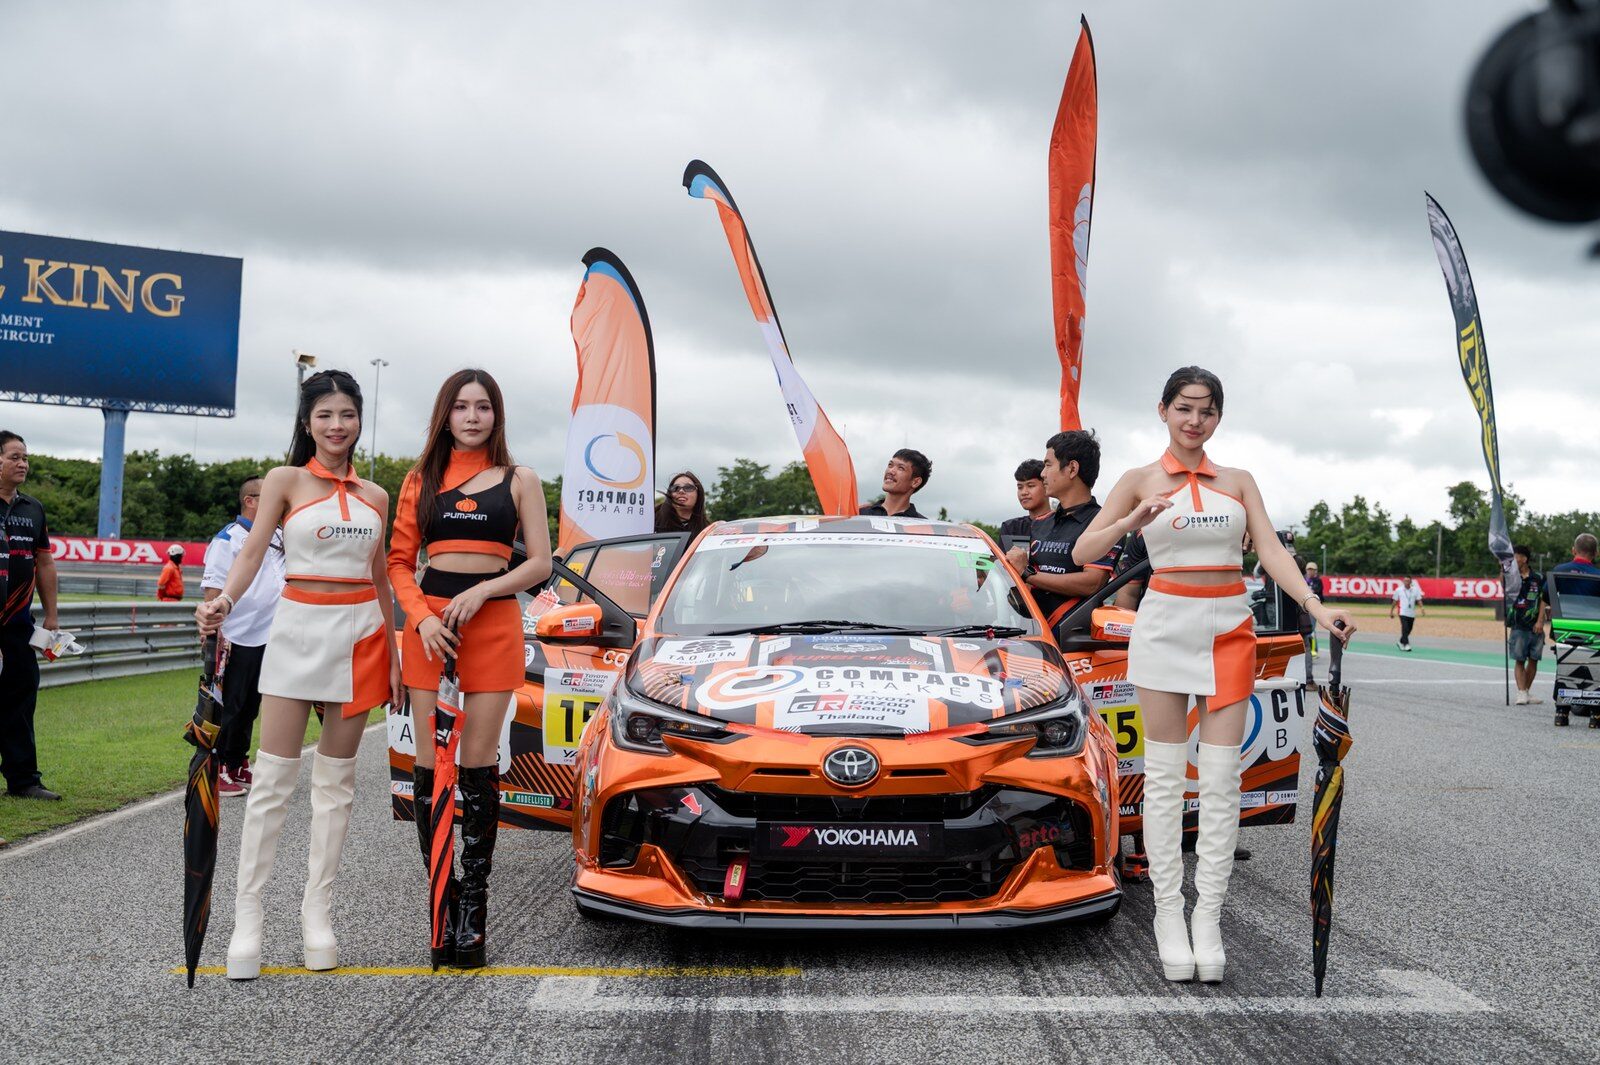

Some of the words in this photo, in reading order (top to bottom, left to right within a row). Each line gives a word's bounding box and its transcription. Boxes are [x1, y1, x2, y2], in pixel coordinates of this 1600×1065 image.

[21, 258, 185, 317] KING
[1, 313, 43, 328] MENT
[0, 328, 55, 344] IRCUIT
[442, 511, 488, 521] PUMPKIN
[1190, 515, 1229, 523] COMPACT
[335, 526, 373, 536] COMPACT
[909, 540, 969, 549] Racing
[49, 540, 162, 563] ONDA
[668, 653, 698, 661] TAO
[708, 651, 736, 659] BIN
[816, 669, 992, 692] COMPACT
[818, 680, 992, 703] BRAKES
[1093, 690, 1112, 699] GR
[853, 694, 915, 703] TOYOTA
[851, 700, 909, 708] GAZOO
[848, 705, 906, 715] Racing
[817, 713, 885, 721] Thailand
[516, 795, 551, 805] MODELLISTA
[814, 828, 918, 847] YOKOHAMA
